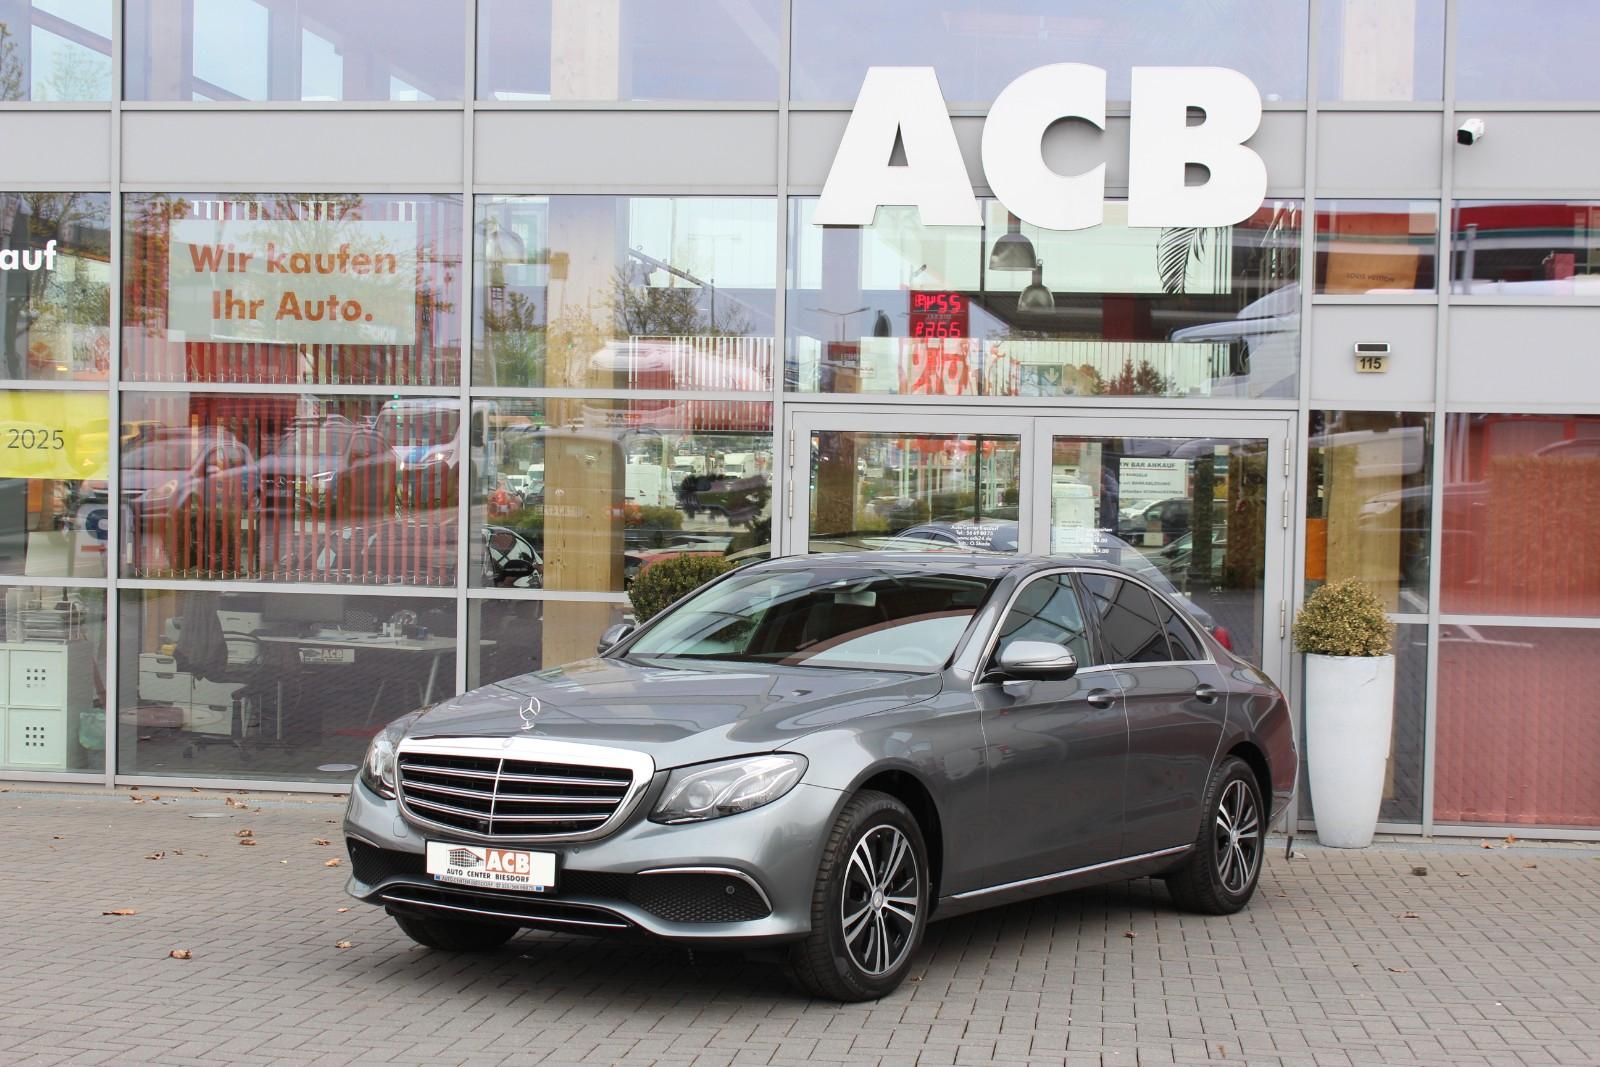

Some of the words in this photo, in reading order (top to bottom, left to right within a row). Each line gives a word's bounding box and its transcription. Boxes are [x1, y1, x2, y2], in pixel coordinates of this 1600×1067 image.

[812, 62, 1267, 231] ACB
[0, 240, 57, 271] auf
[189, 242, 253, 273] Wir
[266, 243, 397, 274] kaufen
[212, 289, 264, 320] Ihr
[275, 291, 374, 322] Auto.
[1360, 357, 1382, 370] 115
[7, 428, 65, 450] 2025
[446, 868, 463, 876] AUTO
[467, 871, 491, 879] CENTER
[495, 874, 530, 883] BIESDORF
[486, 849, 530, 874] ACB
